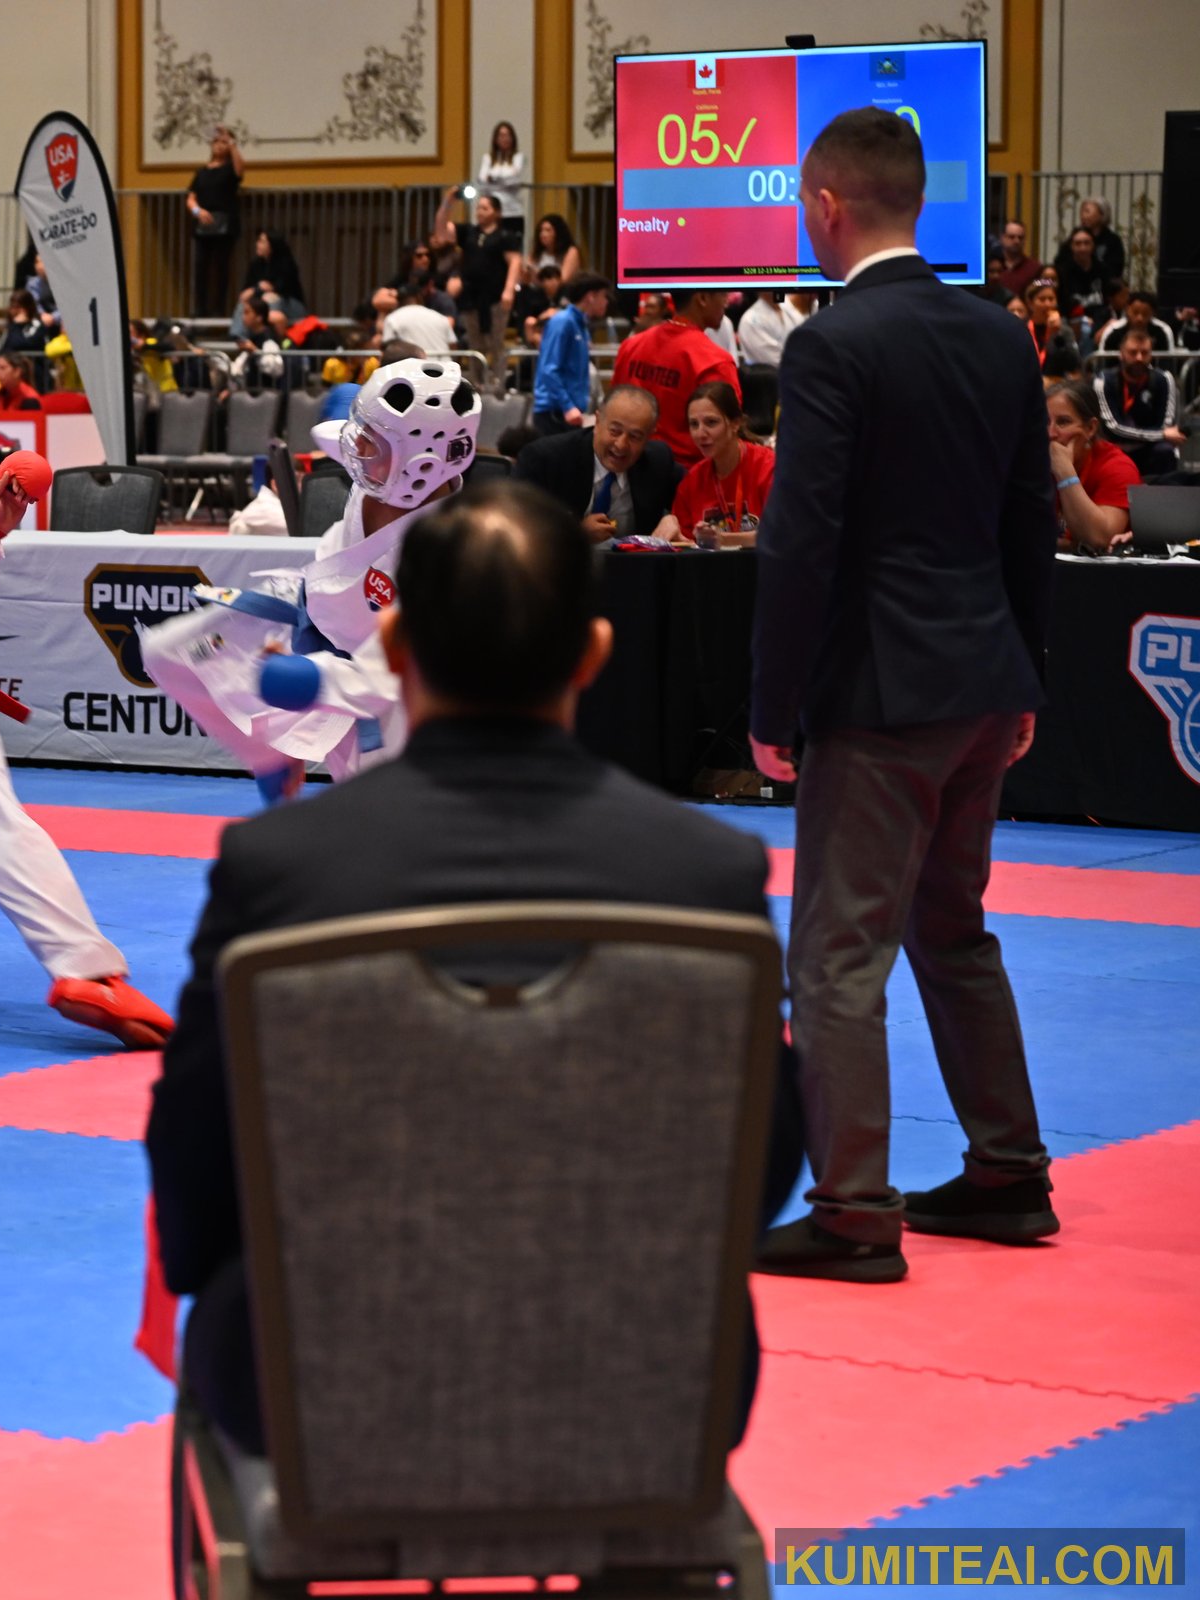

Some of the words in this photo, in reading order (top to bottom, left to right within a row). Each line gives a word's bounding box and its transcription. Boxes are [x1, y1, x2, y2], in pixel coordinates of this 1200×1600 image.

[657, 113, 721, 166] 05
[49, 143, 76, 167] USA
[49, 205, 85, 222] NATIONAL
[618, 217, 669, 235] Penalty
[38, 212, 98, 243] KARATE-DO
[773, 266, 787, 275] Male
[88, 297, 100, 347] 1
[368, 573, 392, 600] USA
